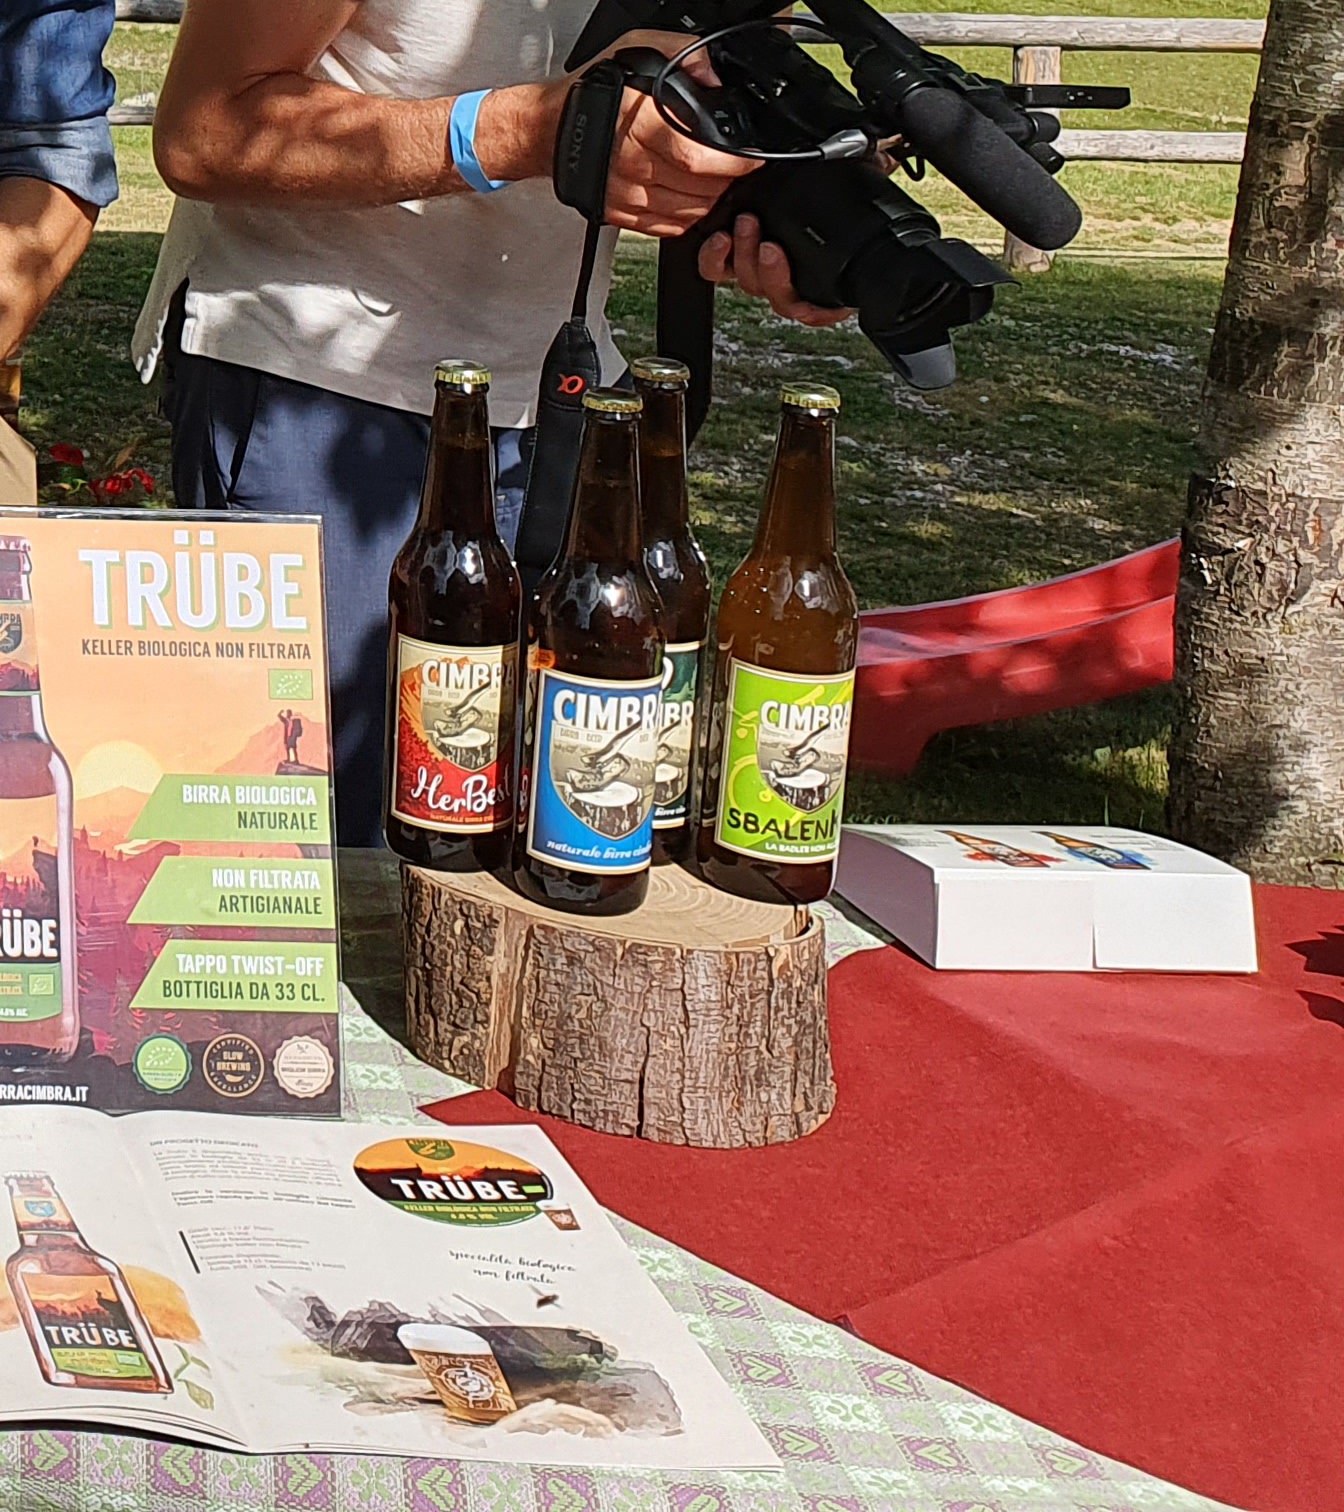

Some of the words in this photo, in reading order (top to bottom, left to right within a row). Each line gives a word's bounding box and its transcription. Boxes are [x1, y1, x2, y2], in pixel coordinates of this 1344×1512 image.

[568, 114, 588, 173] SONY
[78, 530, 309, 630] TRÜBE
[81, 639, 134, 658] KELLER
[137, 639, 212, 659] BIOLOGICA
[215, 641, 245, 660] NON
[247, 641, 312, 661] FILTRATA
[182, 784, 231, 805] BIRRA
[235, 785, 317, 806] BIOLOGICA
[237, 810, 319, 832] NATURALE
[212, 869, 245, 889] NON
[249, 869, 321, 890] FILTRATA
[218, 894, 323, 915] ARTIGIANALE
[176, 953, 228, 975] TAPPO
[231, 955, 324, 977] TWIST-OFF
[162, 980, 244, 1001] BOTTIGLIA
[248, 981, 272, 1002] DA
[275, 982, 297, 1002] 33
[301, 981, 326, 1003] CL.
[390, 1175, 527, 1200] TRÜBE
[44, 1322, 138, 1349] TRÜBE
